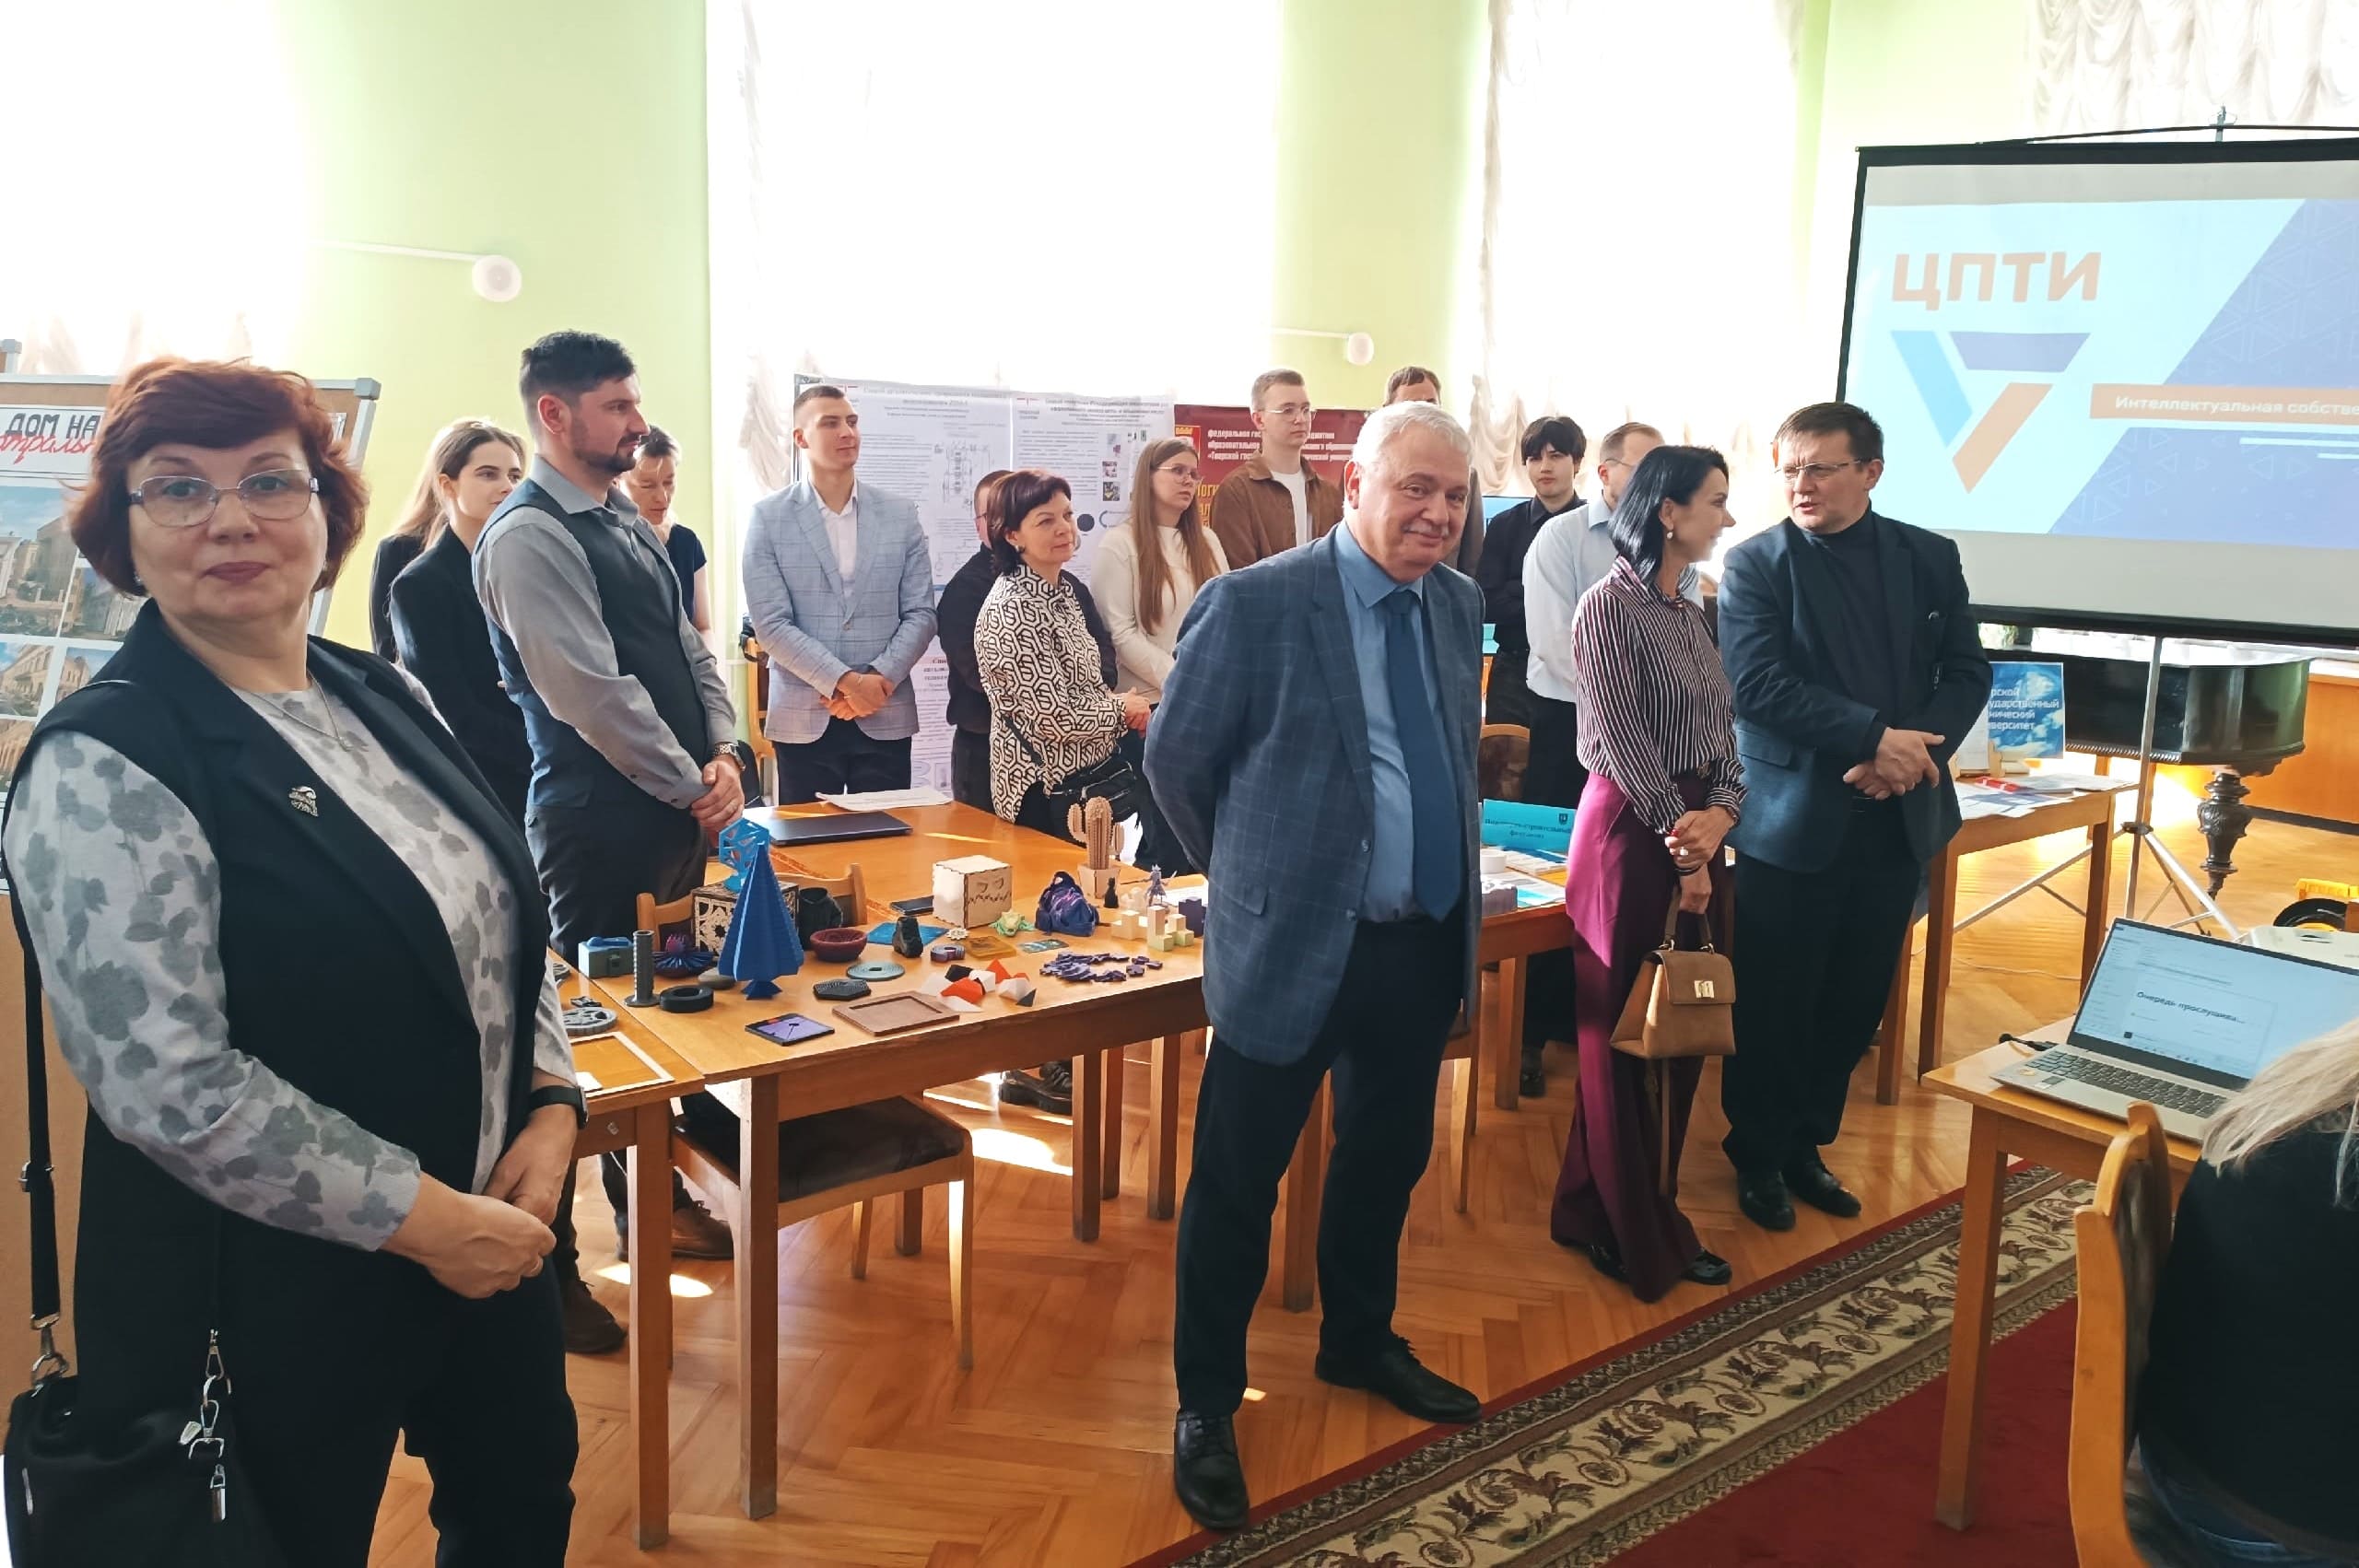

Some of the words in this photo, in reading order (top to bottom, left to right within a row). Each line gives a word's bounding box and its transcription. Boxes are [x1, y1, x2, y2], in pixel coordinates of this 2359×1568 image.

[1891, 251, 2102, 311] ЦПТИ
[2115, 395, 2283, 415] Интеллектуальная
[6, 412, 60, 439] ДОМ
[66, 414, 101, 440] НА
[1990, 687, 2020, 699] рской
[1989, 698, 2060, 709] ударственный
[1989, 708, 2036, 719] нический
[1988, 721, 2036, 731] верситет
